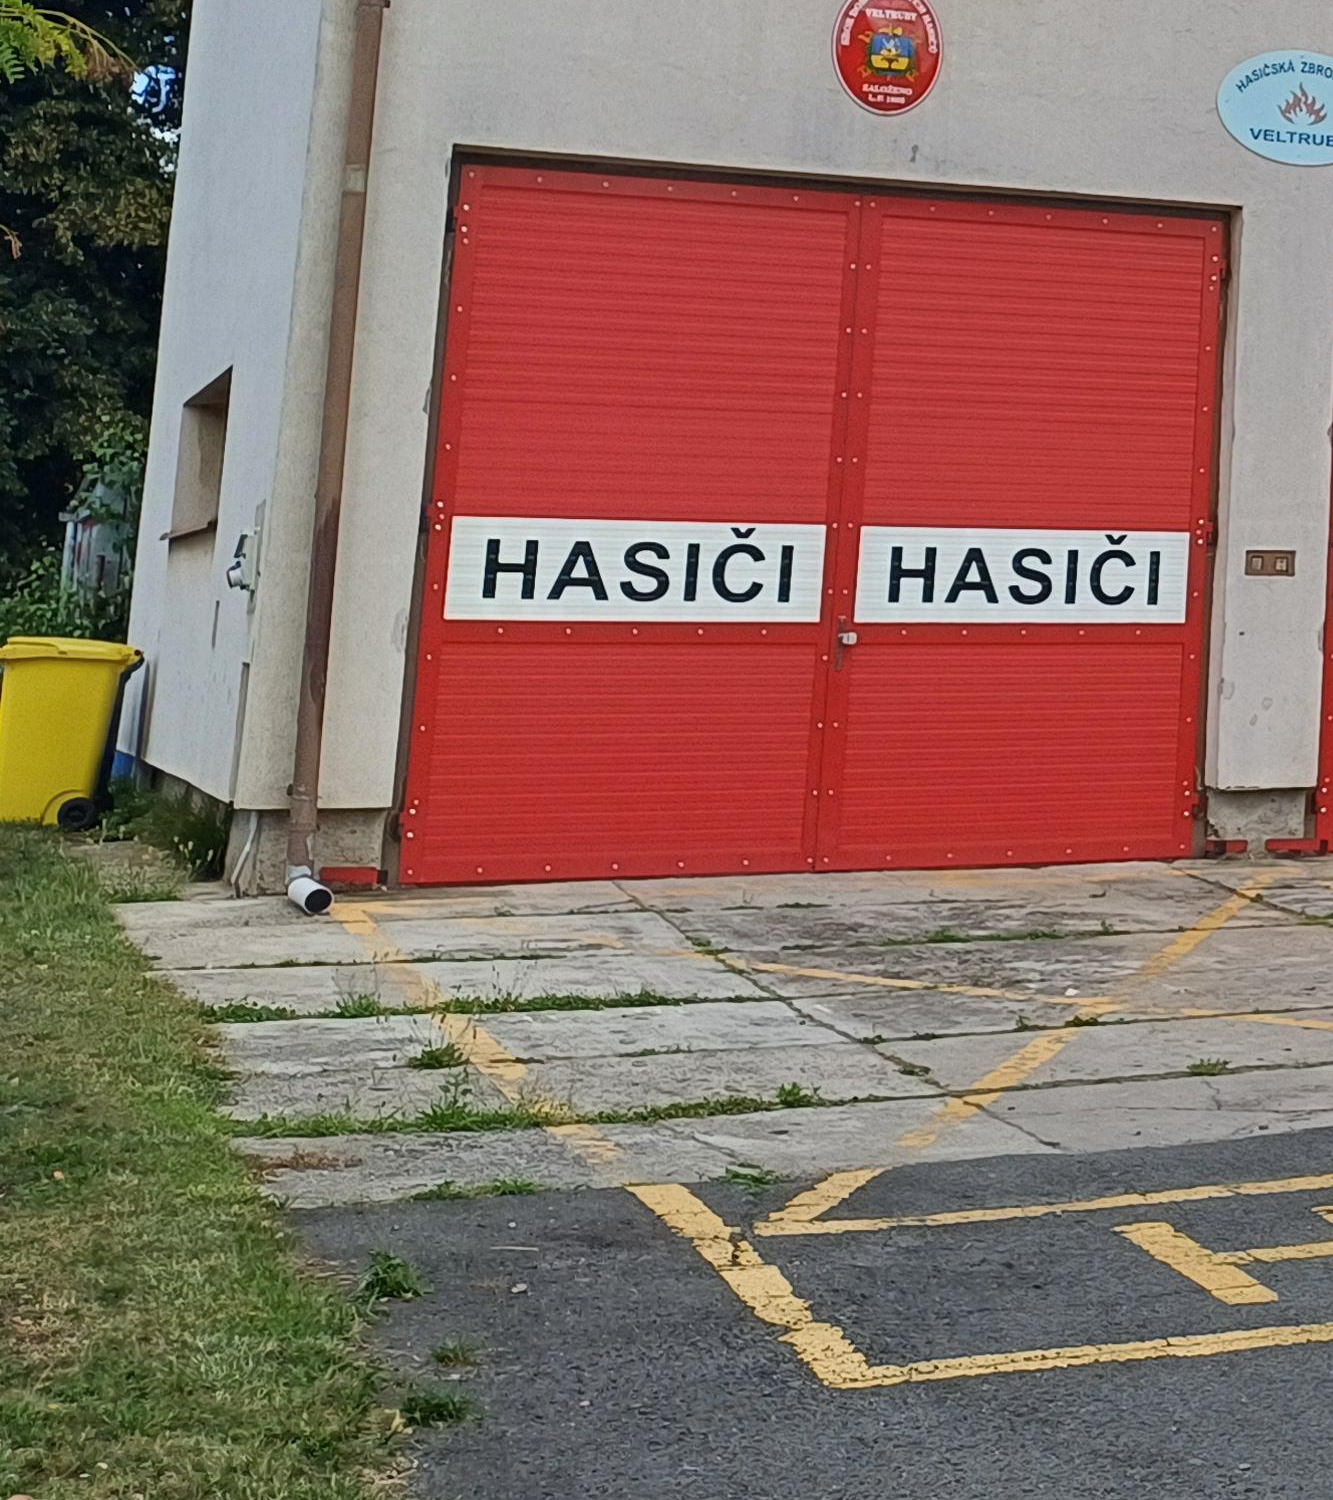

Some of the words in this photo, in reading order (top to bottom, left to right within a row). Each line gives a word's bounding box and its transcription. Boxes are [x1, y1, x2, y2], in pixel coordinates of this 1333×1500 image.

[1235, 58, 1296, 93] HASIČSKÁ
[483, 528, 795, 603] HASIČI
[888, 535, 1161, 606] HASIČI
